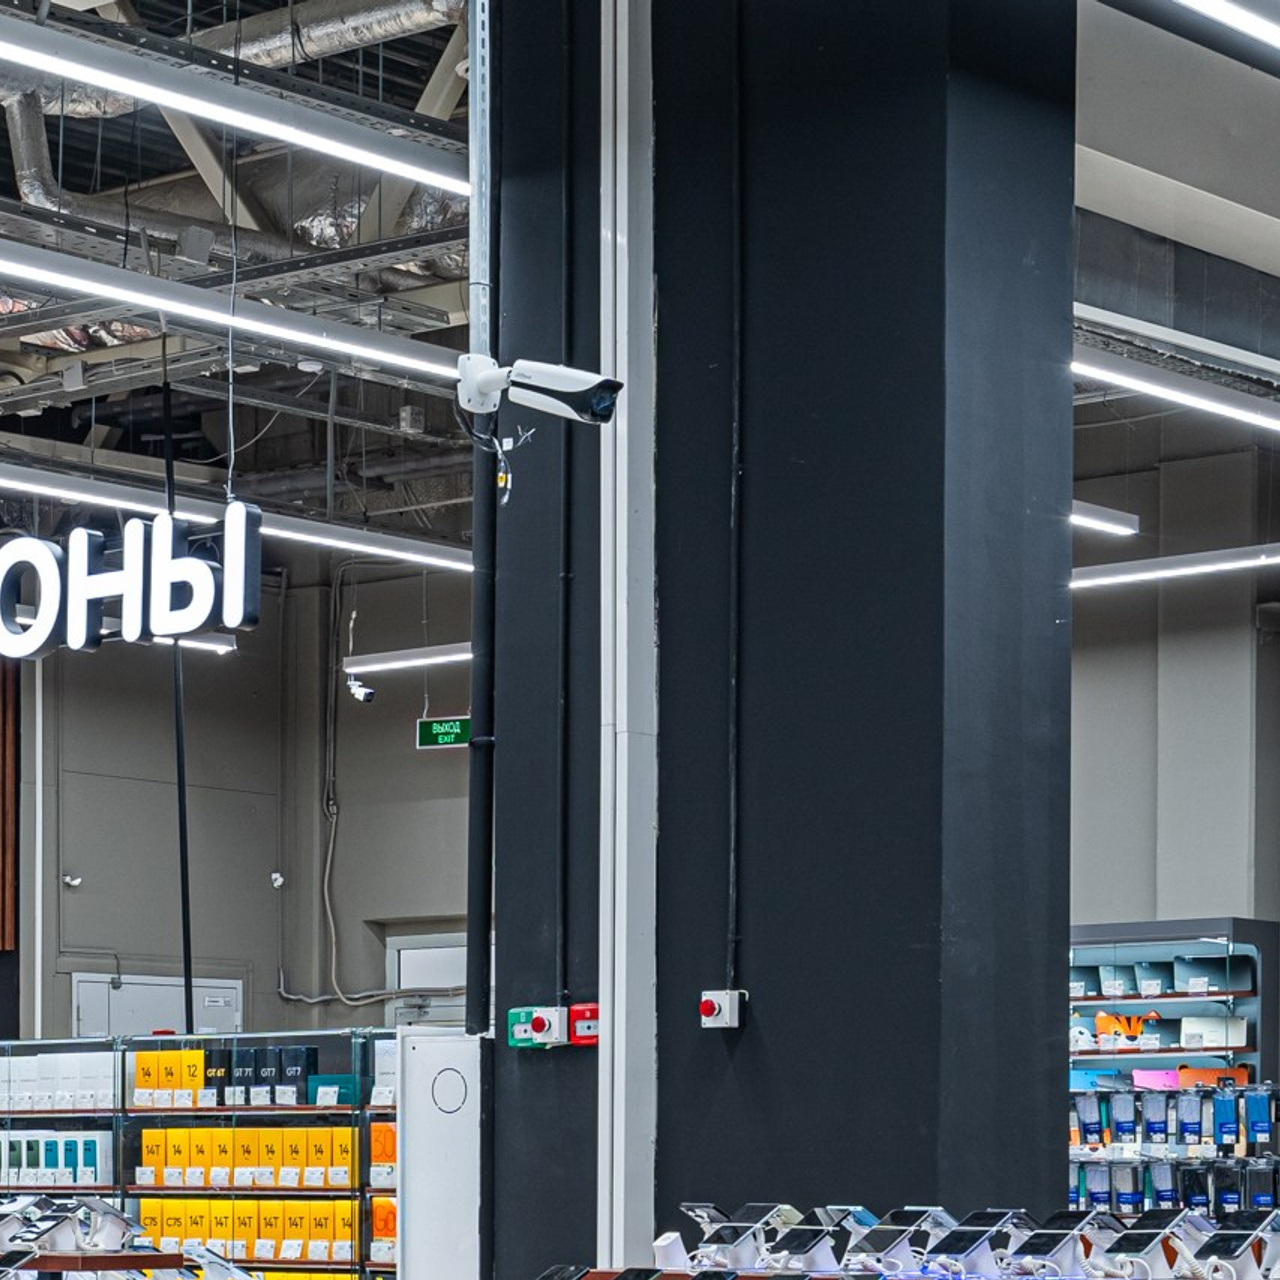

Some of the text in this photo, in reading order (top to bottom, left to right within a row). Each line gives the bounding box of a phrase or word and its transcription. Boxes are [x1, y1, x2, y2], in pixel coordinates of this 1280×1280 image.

[432, 721, 461, 734] ВЫХОД
[437, 734, 455, 743] EXIT
[187, 1064, 197, 1078] 12
[173, 1144, 182, 1156] 14
[195, 1144, 205, 1156] 14
[218, 1144, 228, 1156] 14
[241, 1144, 251, 1156] 14
[265, 1144, 276, 1156] 14
[289, 1144, 300, 1156] 14
[314, 1144, 324, 1156] 14
[339, 1144, 349, 1156] 14
[189, 1215, 204, 1227] 14T
[214, 1216, 229, 1228] 14T
[237, 1216, 253, 1229] 14T
[263, 1217, 279, 1229] 14T
[288, 1216, 305, 1229] 14T
[314, 1217, 330, 1229] 14T
